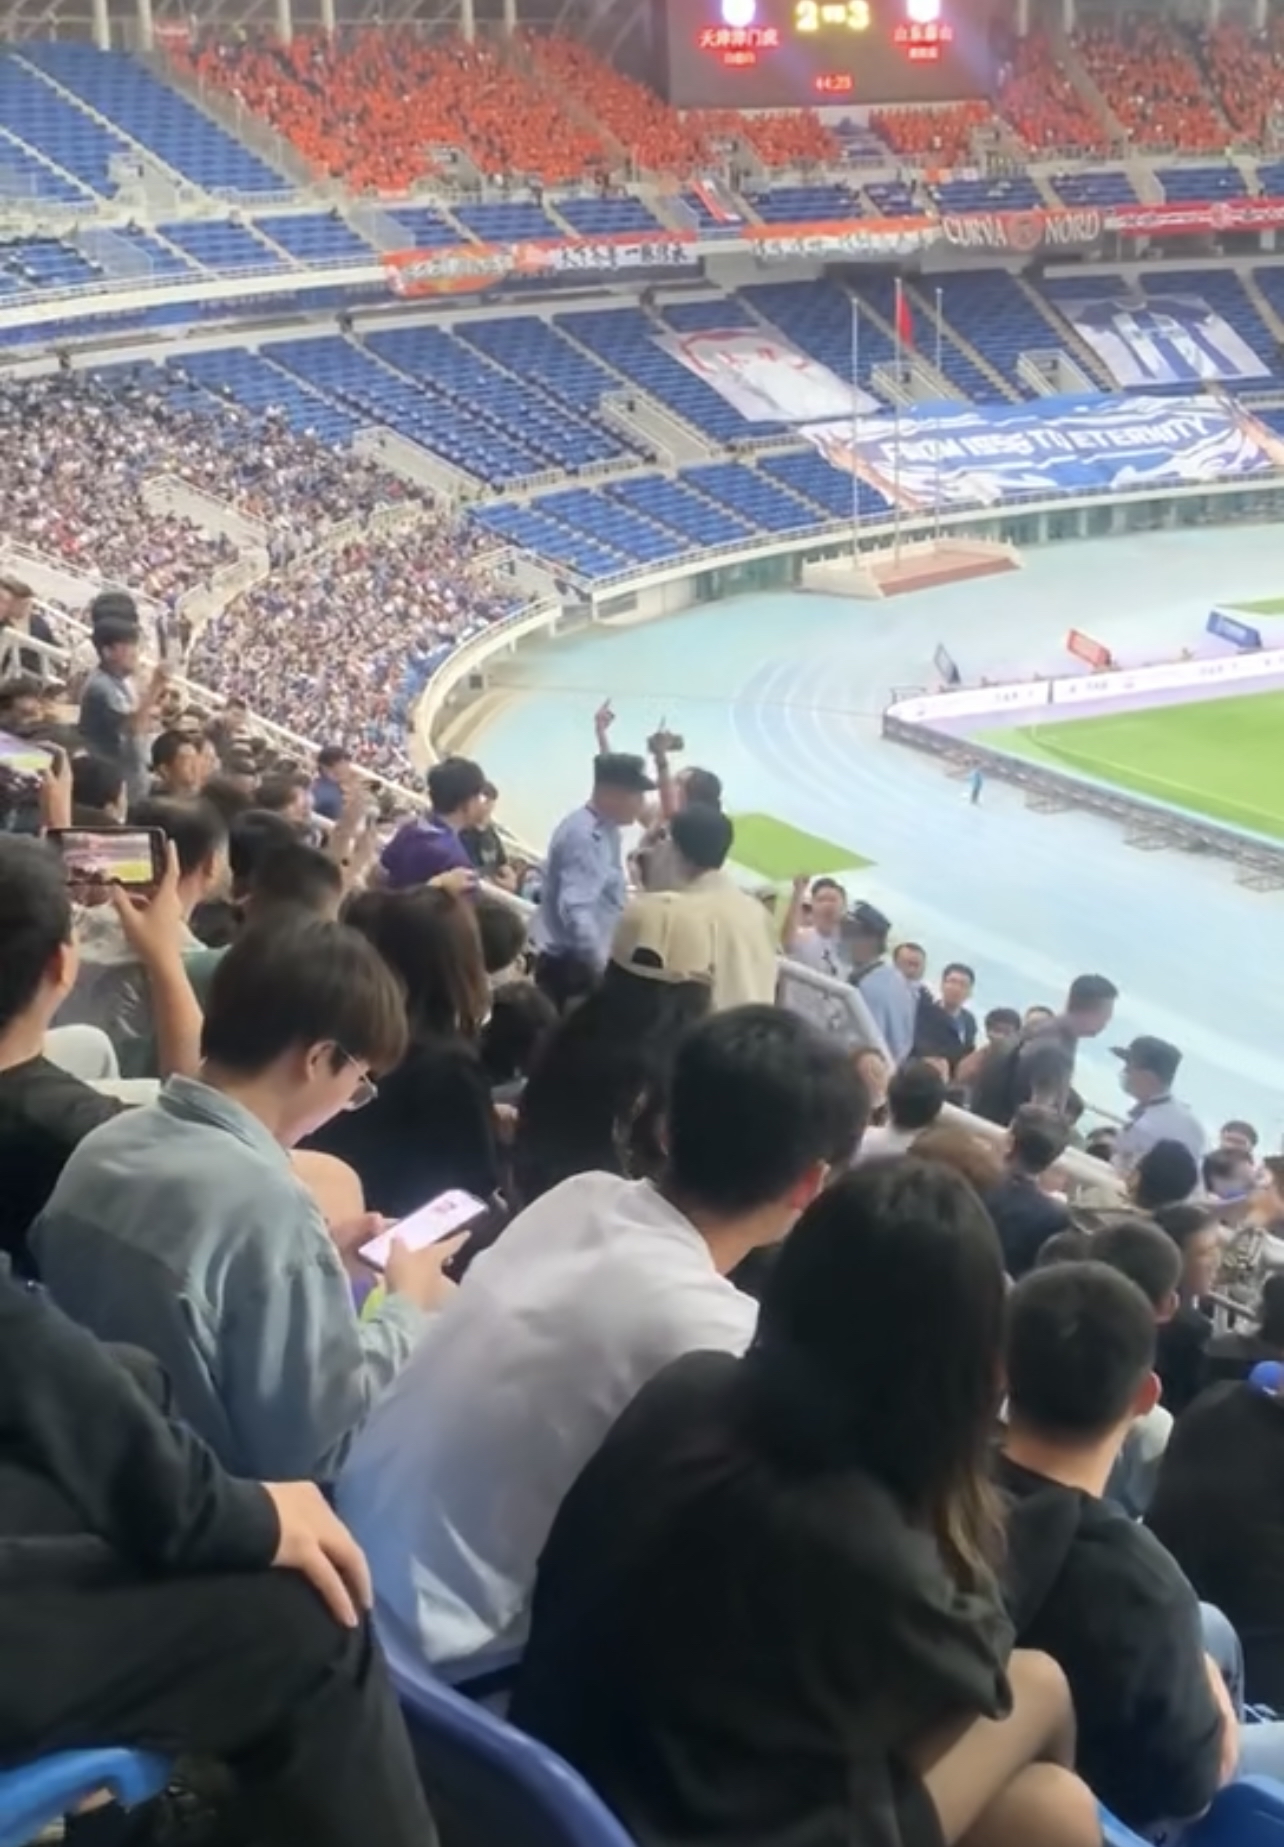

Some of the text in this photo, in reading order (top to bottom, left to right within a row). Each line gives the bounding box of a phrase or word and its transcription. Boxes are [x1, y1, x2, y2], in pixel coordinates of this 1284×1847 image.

[943, 212, 1008, 246] CURVA
[1045, 208, 1100, 244] NORD
[1065, 415, 1208, 450] ETERNITY
